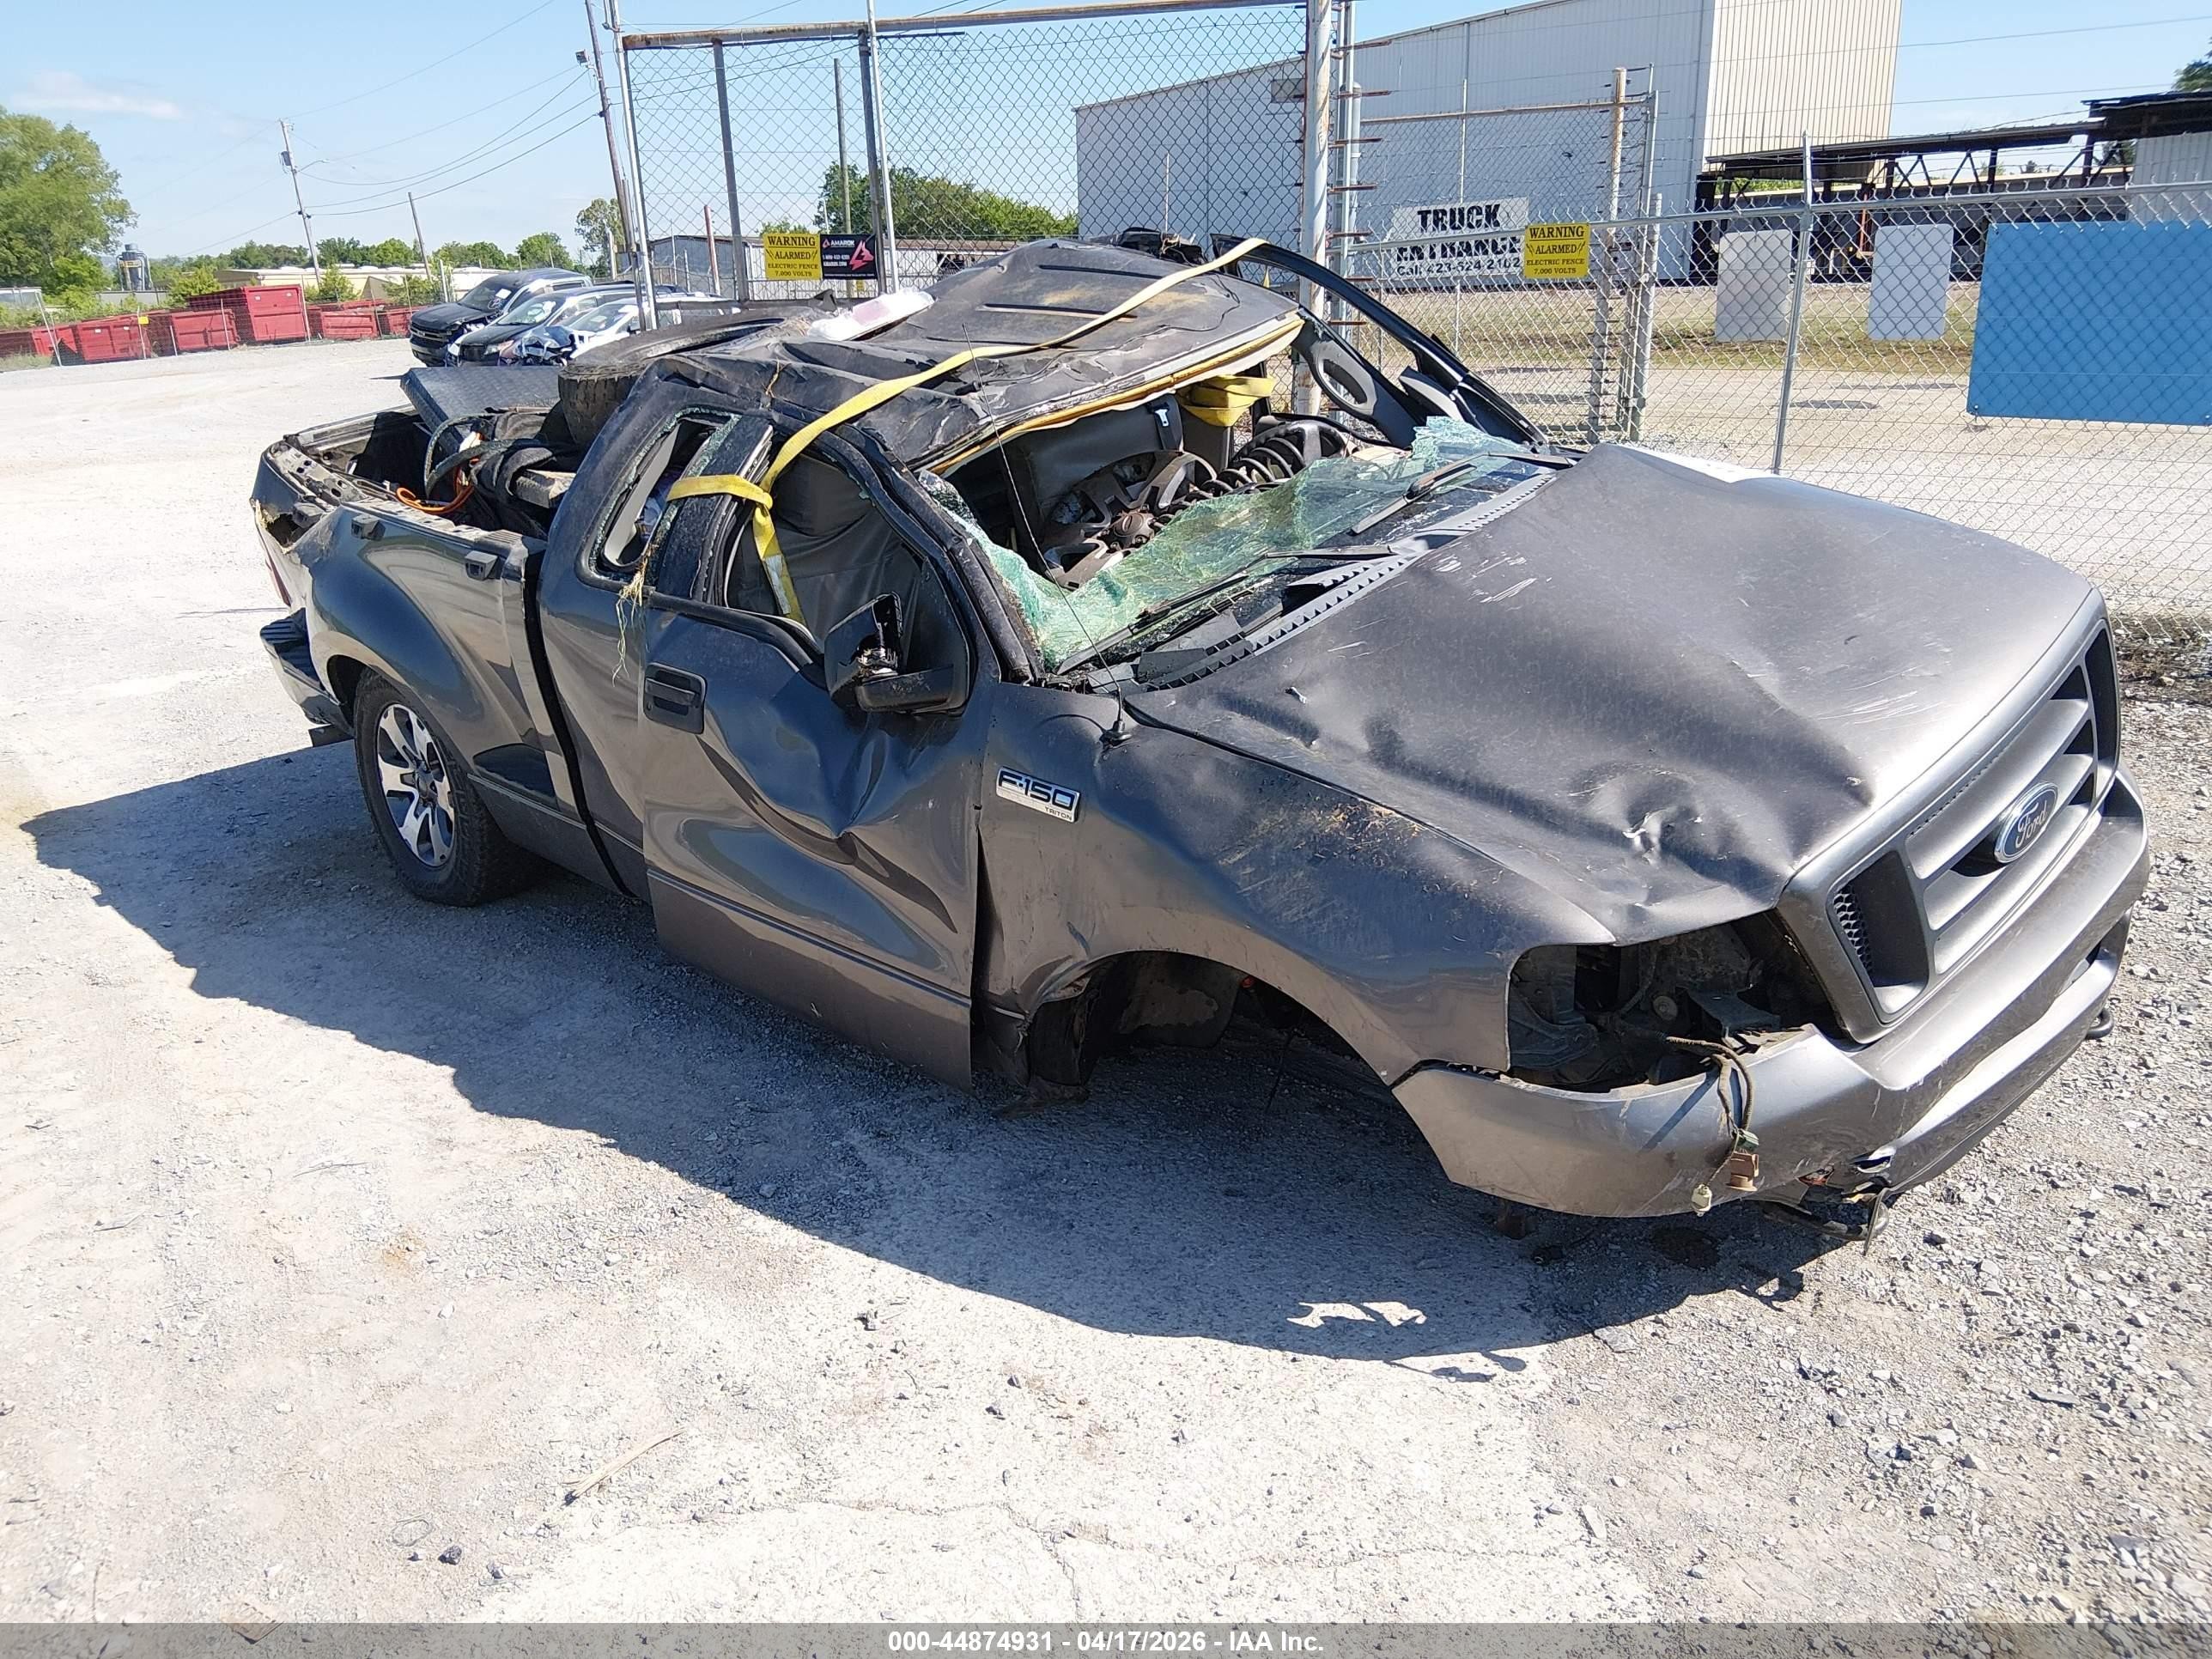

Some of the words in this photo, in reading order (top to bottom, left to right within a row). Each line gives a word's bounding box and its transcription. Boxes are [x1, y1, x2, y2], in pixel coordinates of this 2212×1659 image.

[1417, 204, 1501, 233] TRUCK
[1529, 226, 1585, 239] WARNING
[768, 236, 816, 246] WARNING
[775, 251, 811, 260] ALARMED
[1535, 244, 1577, 255] ALARMED
[998, 770, 1076, 811] F-150
[1044, 805, 1073, 822] TRITON
[2014, 799, 2048, 848] Ford
